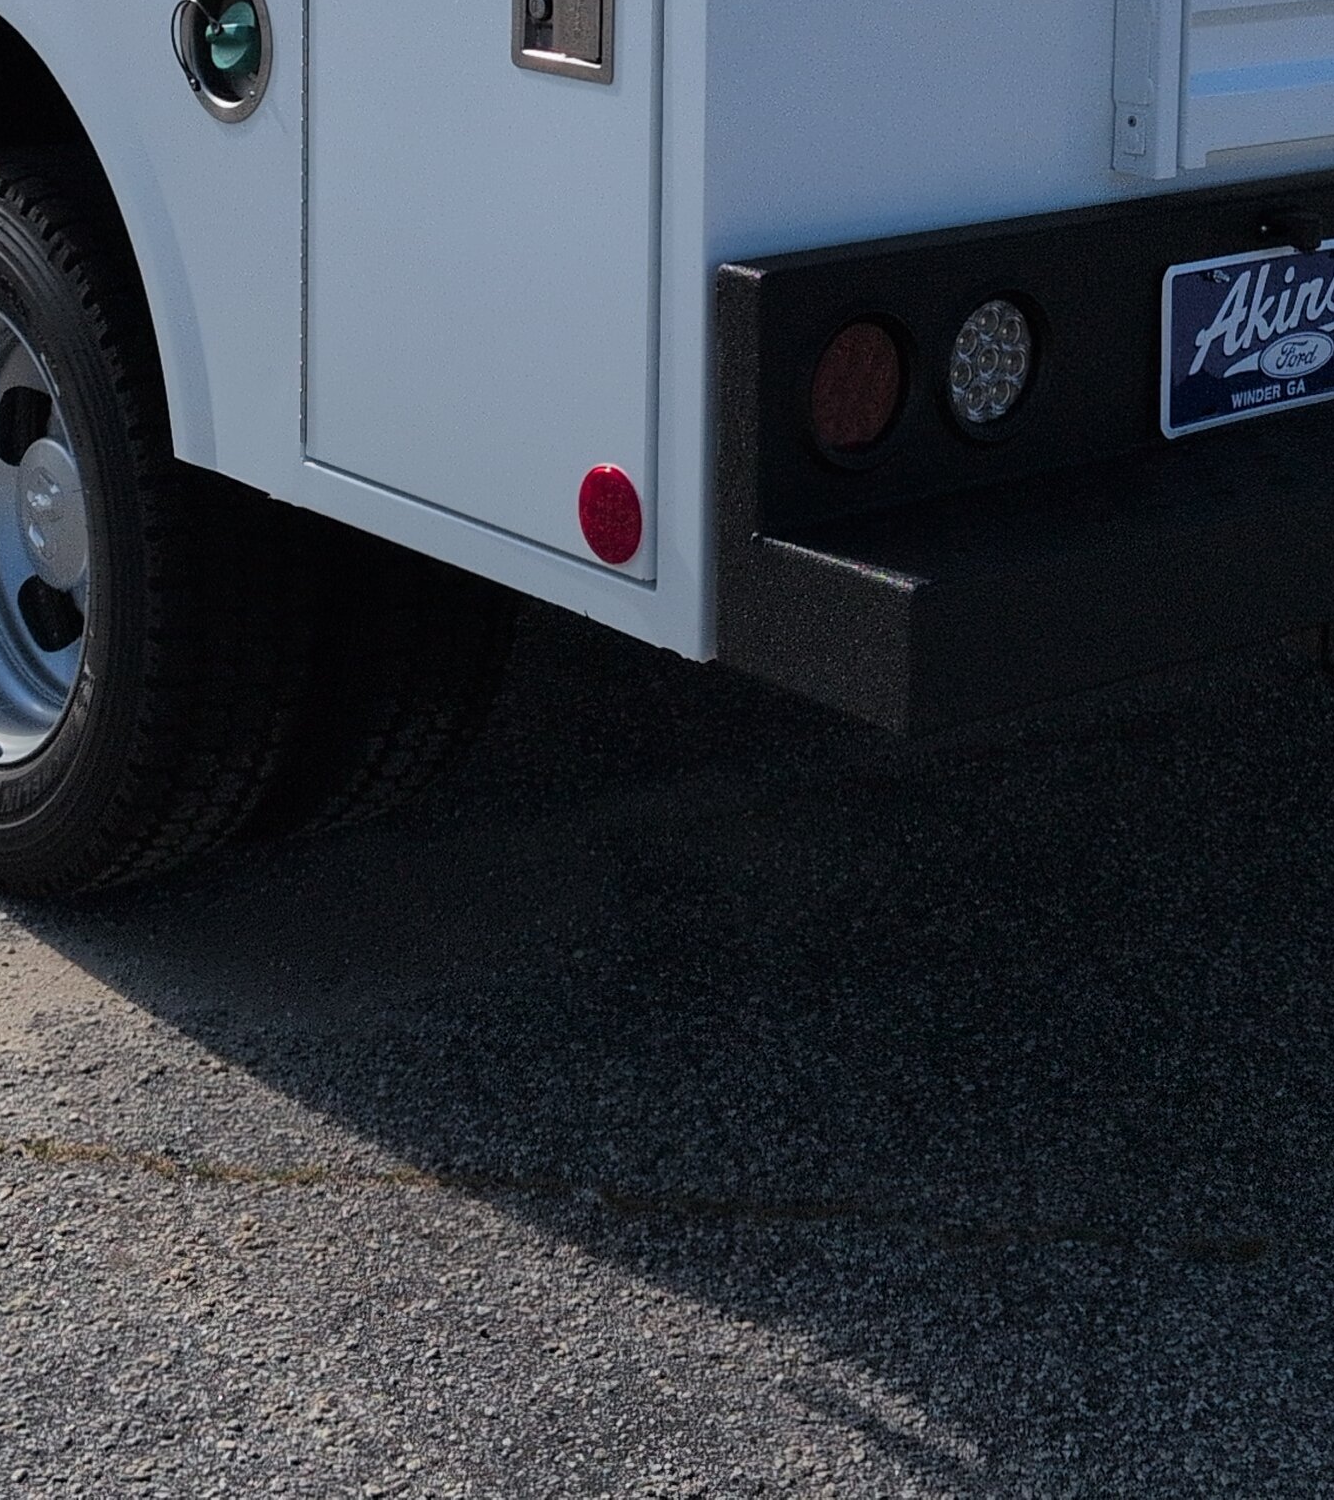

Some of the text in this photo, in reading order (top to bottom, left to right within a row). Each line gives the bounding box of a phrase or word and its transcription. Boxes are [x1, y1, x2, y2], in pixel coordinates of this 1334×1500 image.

[1276, 340, 1317, 370] Ford
[1231, 378, 1306, 409] WINDER GA
